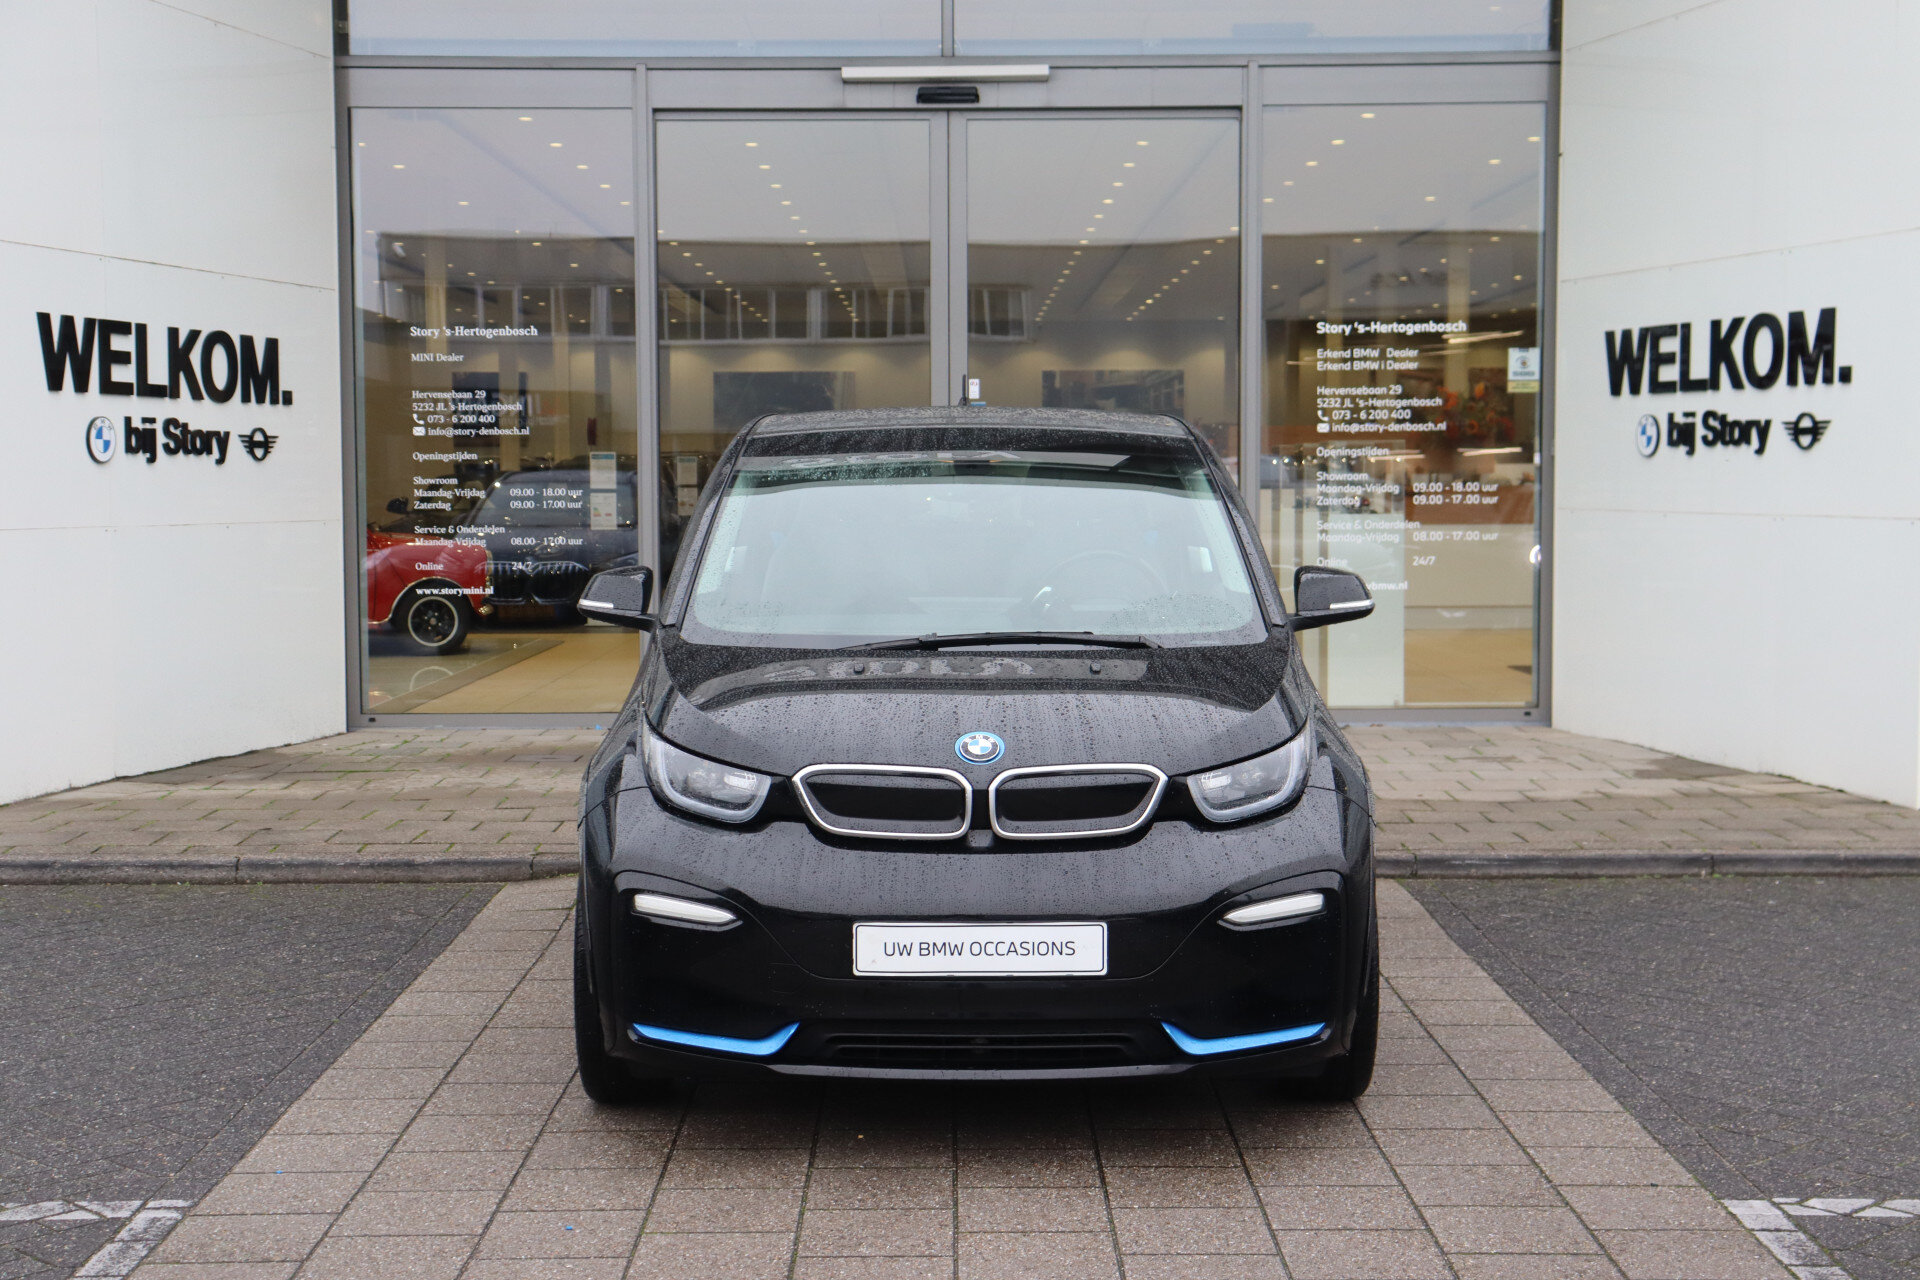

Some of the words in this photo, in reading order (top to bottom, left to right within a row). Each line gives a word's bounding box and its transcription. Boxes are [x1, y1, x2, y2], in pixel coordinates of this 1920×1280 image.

[410, 326, 440, 338] Story
[1316, 322, 1352, 336] Story
[1317, 349, 1350, 358] Erkend
[1353, 349, 1380, 358] BMW
[1387, 348, 1419, 358] Dealer
[1605, 307, 1853, 397] WELKOM.
[36, 312, 293, 406] WELKOM.
[411, 353, 434, 362] MINI
[436, 353, 464, 362] Dealer
[1317, 361, 1350, 370] Erkend
[1353, 361, 1380, 370] BMW
[1381, 360, 1384, 370] i
[1387, 360, 1419, 370] Dealer
[475, 390, 486, 398] 29
[1317, 386, 1387, 395] Hervensebaan
[1389, 385, 1402, 395] 29
[412, 403, 434, 411] 5232
[436, 403, 447, 411] JL
[1317, 398, 1340, 408] 5232
[1343, 398, 1354, 407] JL
[427, 415, 444, 423] 073
[452, 415, 458, 423] 6
[460, 415, 476, 423] 200
[478, 415, 495, 423] 400
[1332, 410, 1351, 420] 073
[1360, 410, 1367, 420] 6
[1368, 410, 1388, 419] 200
[1391, 409, 1411, 419] 400
[428, 427, 530, 437] info@story-denbosch.nl
[1667, 412, 1696, 456] bij
[1701, 410, 1772, 455] Story
[124, 416, 157, 464] bij
[162, 417, 230, 465] Story
[413, 452, 478, 461] Openingstijden
[1317, 447, 1389, 458] Openingstijden
[414, 477, 458, 485] Showroom
[1317, 472, 1368, 481] Showroom
[414, 488, 486, 498] Maandag-Vrijdag
[510, 488, 534, 496] 09.00
[542, 488, 566, 496] 18.00
[1317, 483, 1400, 495] Maandag-Vrijdag
[1413, 482, 1443, 492] 09.00
[1451, 482, 1479, 492] 18.00
[1482, 484, 1498, 492] uur
[414, 501, 451, 511] Zaterdag
[510, 501, 534, 509] 09.00
[543, 500, 565, 508] 17.00
[1317, 496, 1360, 507] Zaterdag
[1413, 494, 1443, 505] 09.00
[1451, 494, 1480, 504] 17.00
[1482, 496, 1498, 504] uur
[457, 525, 505, 533] Onderdelen
[1317, 521, 1352, 530] Service
[1354, 520, 1361, 529] &
[1364, 520, 1420, 529] Onderdelen
[511, 537, 535, 545] 08.00
[1413, 531, 1443, 541] 08.00
[512, 562, 532, 570] 24/7
[1317, 557, 1348, 566] Online
[1413, 556, 1436, 566] 24/7
[416, 586, 494, 595] www.storymini.nl
[884, 942, 913, 957] UW
[919, 941, 964, 956] BMW
[970, 941, 1076, 956] OCCASIONS
